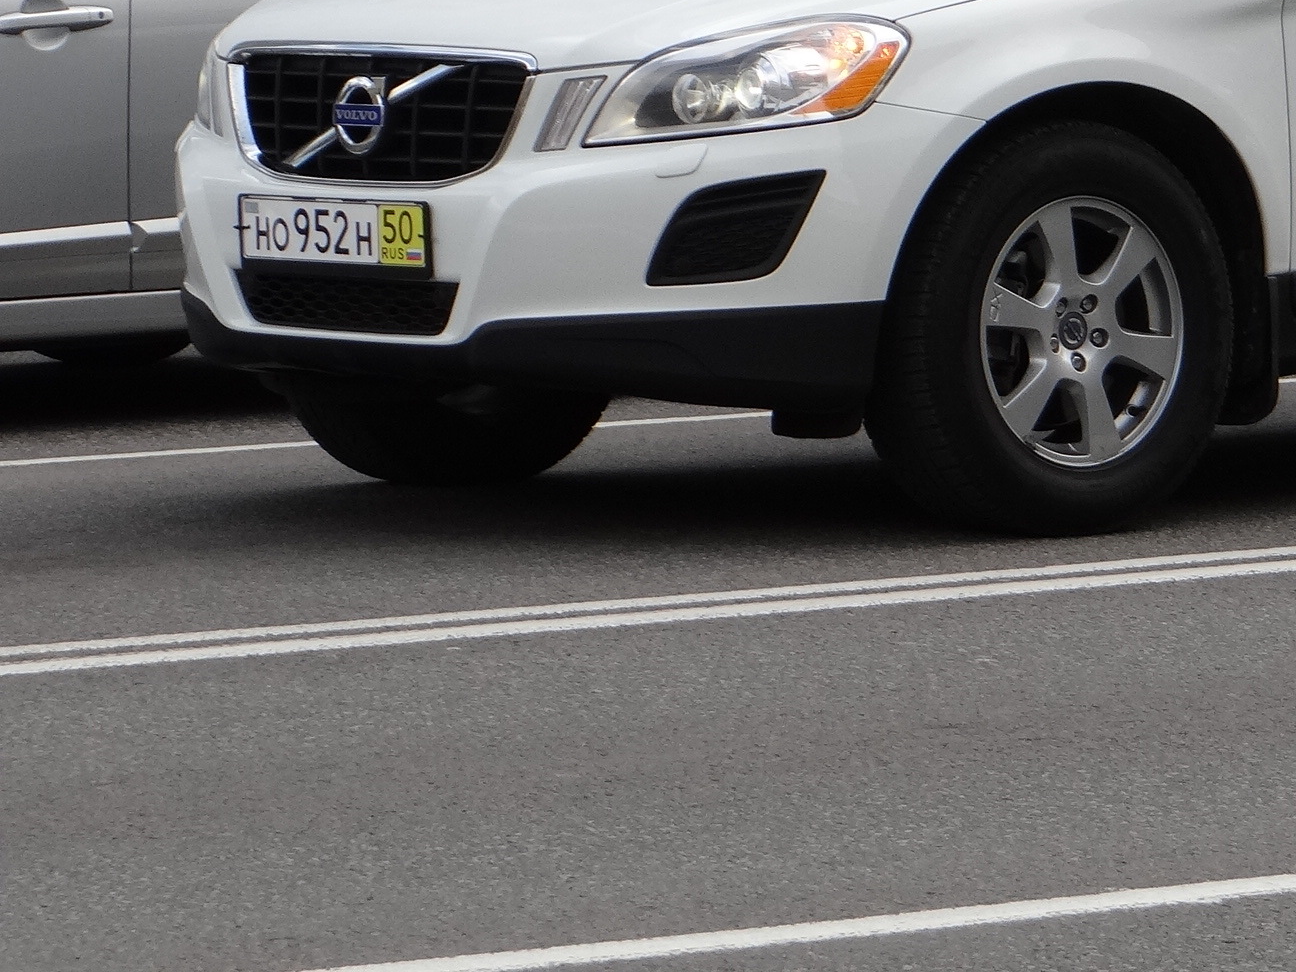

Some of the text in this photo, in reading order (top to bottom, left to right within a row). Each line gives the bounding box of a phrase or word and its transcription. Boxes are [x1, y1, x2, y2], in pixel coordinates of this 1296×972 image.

[335, 108, 378, 121] VOLVO
[254, 208, 373, 256] HO952H
[382, 210, 414, 245] 50
[381, 246, 405, 260] RUS
